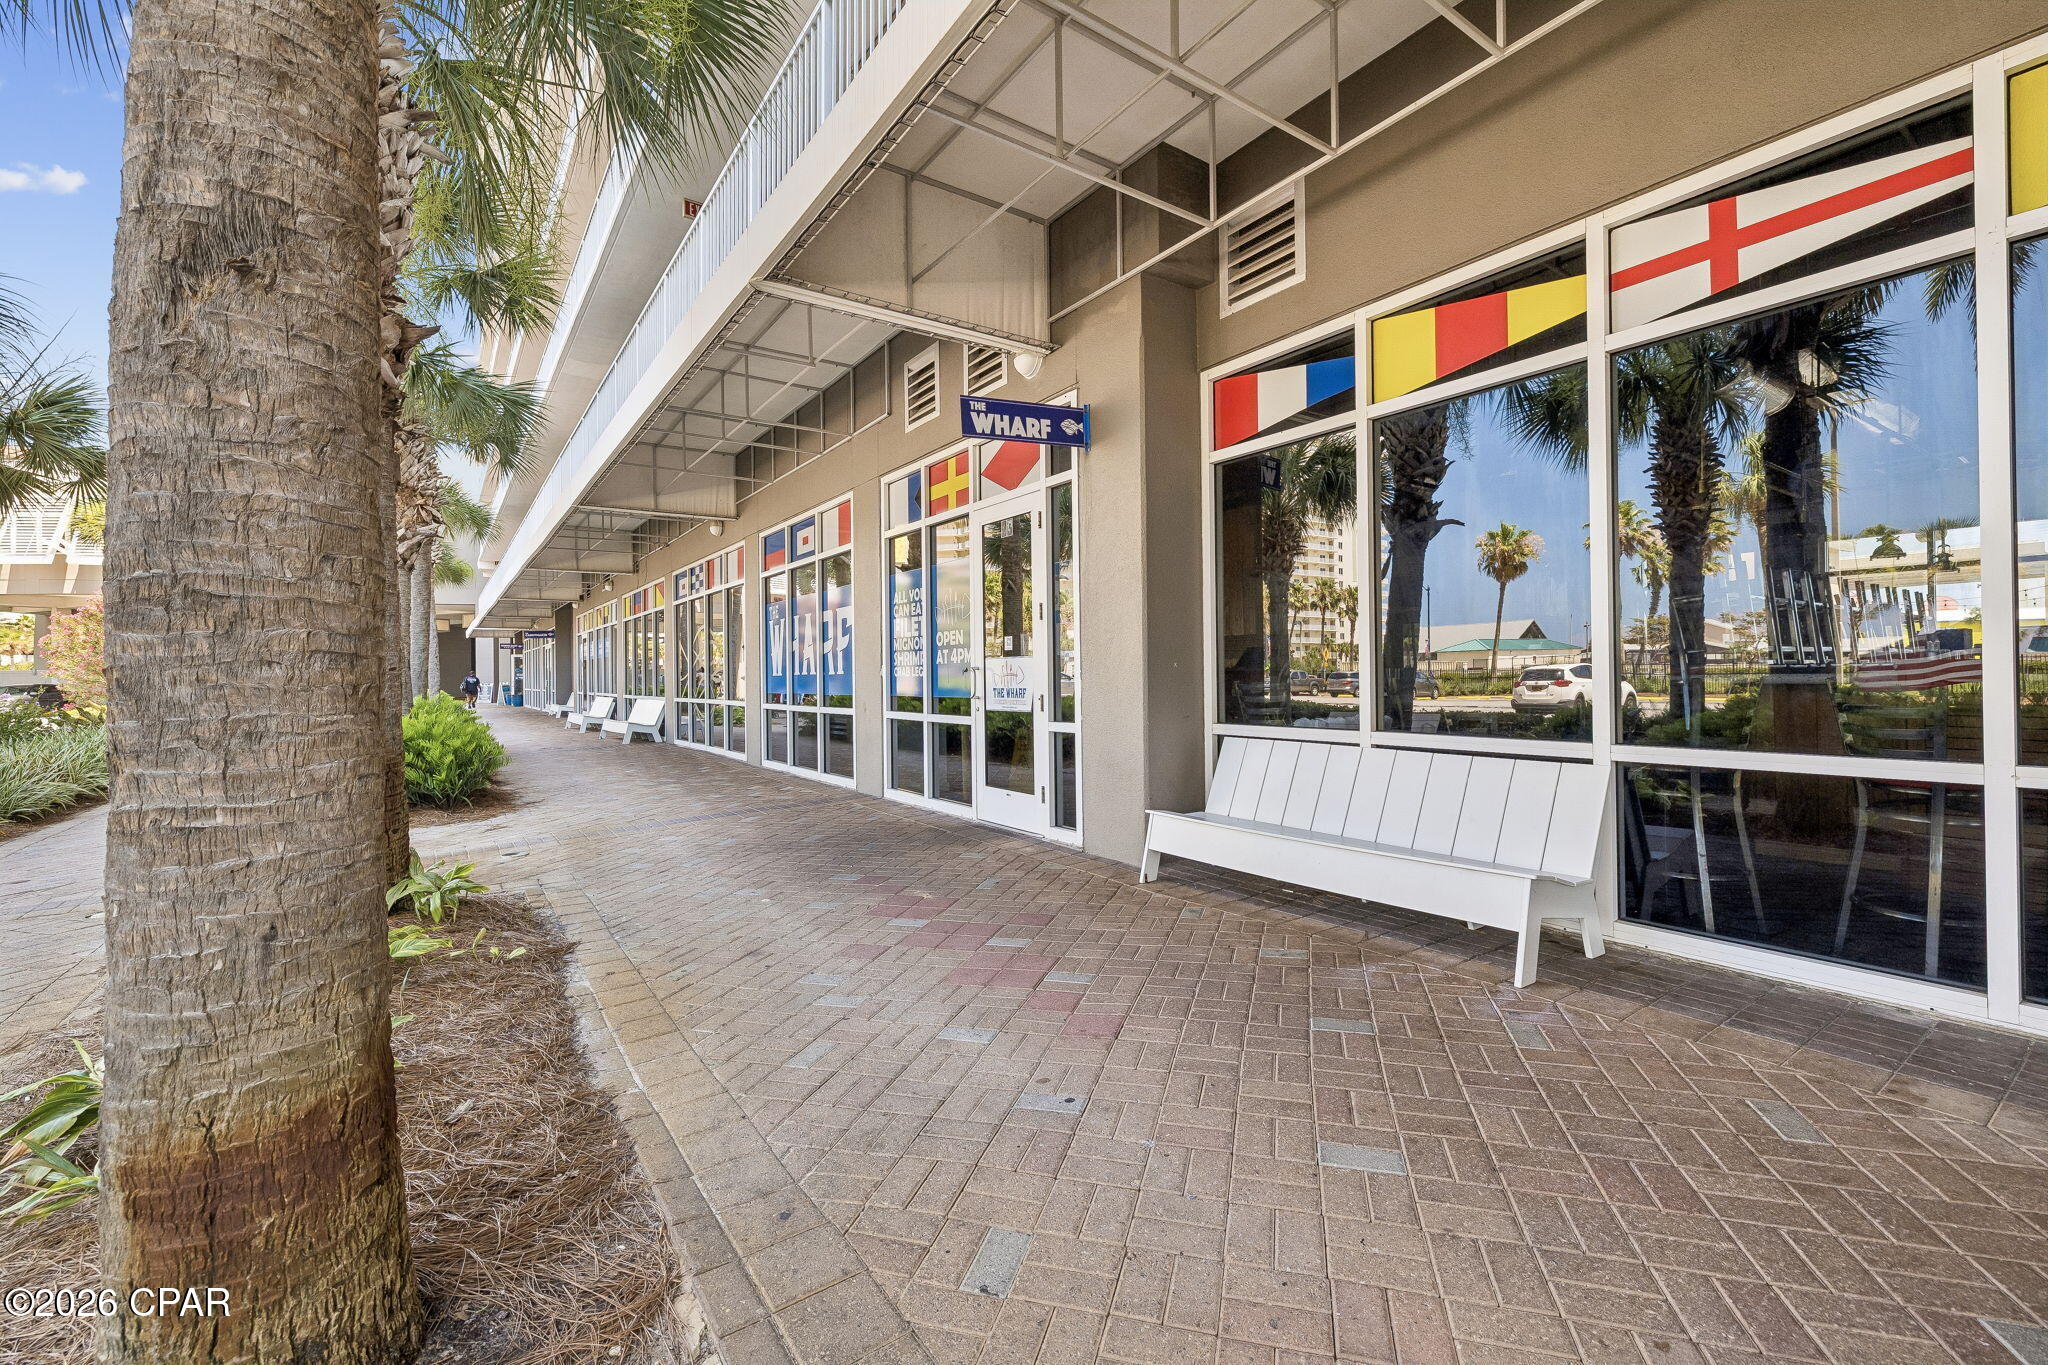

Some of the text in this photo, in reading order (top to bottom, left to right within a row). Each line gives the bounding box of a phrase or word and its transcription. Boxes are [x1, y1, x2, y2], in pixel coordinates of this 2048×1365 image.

[969, 400, 986, 411] THE
[970, 412, 1051, 439] WHARF
[894, 588, 923, 605] ALL YO
[894, 602, 922, 618] CAN EA
[894, 616, 922, 638] FILE
[936, 629, 964, 646] OPEN
[936, 647, 972, 665] AT 4PM
[911, 666, 923, 677] LEG
[993, 687, 1027, 699] THE WHARF
